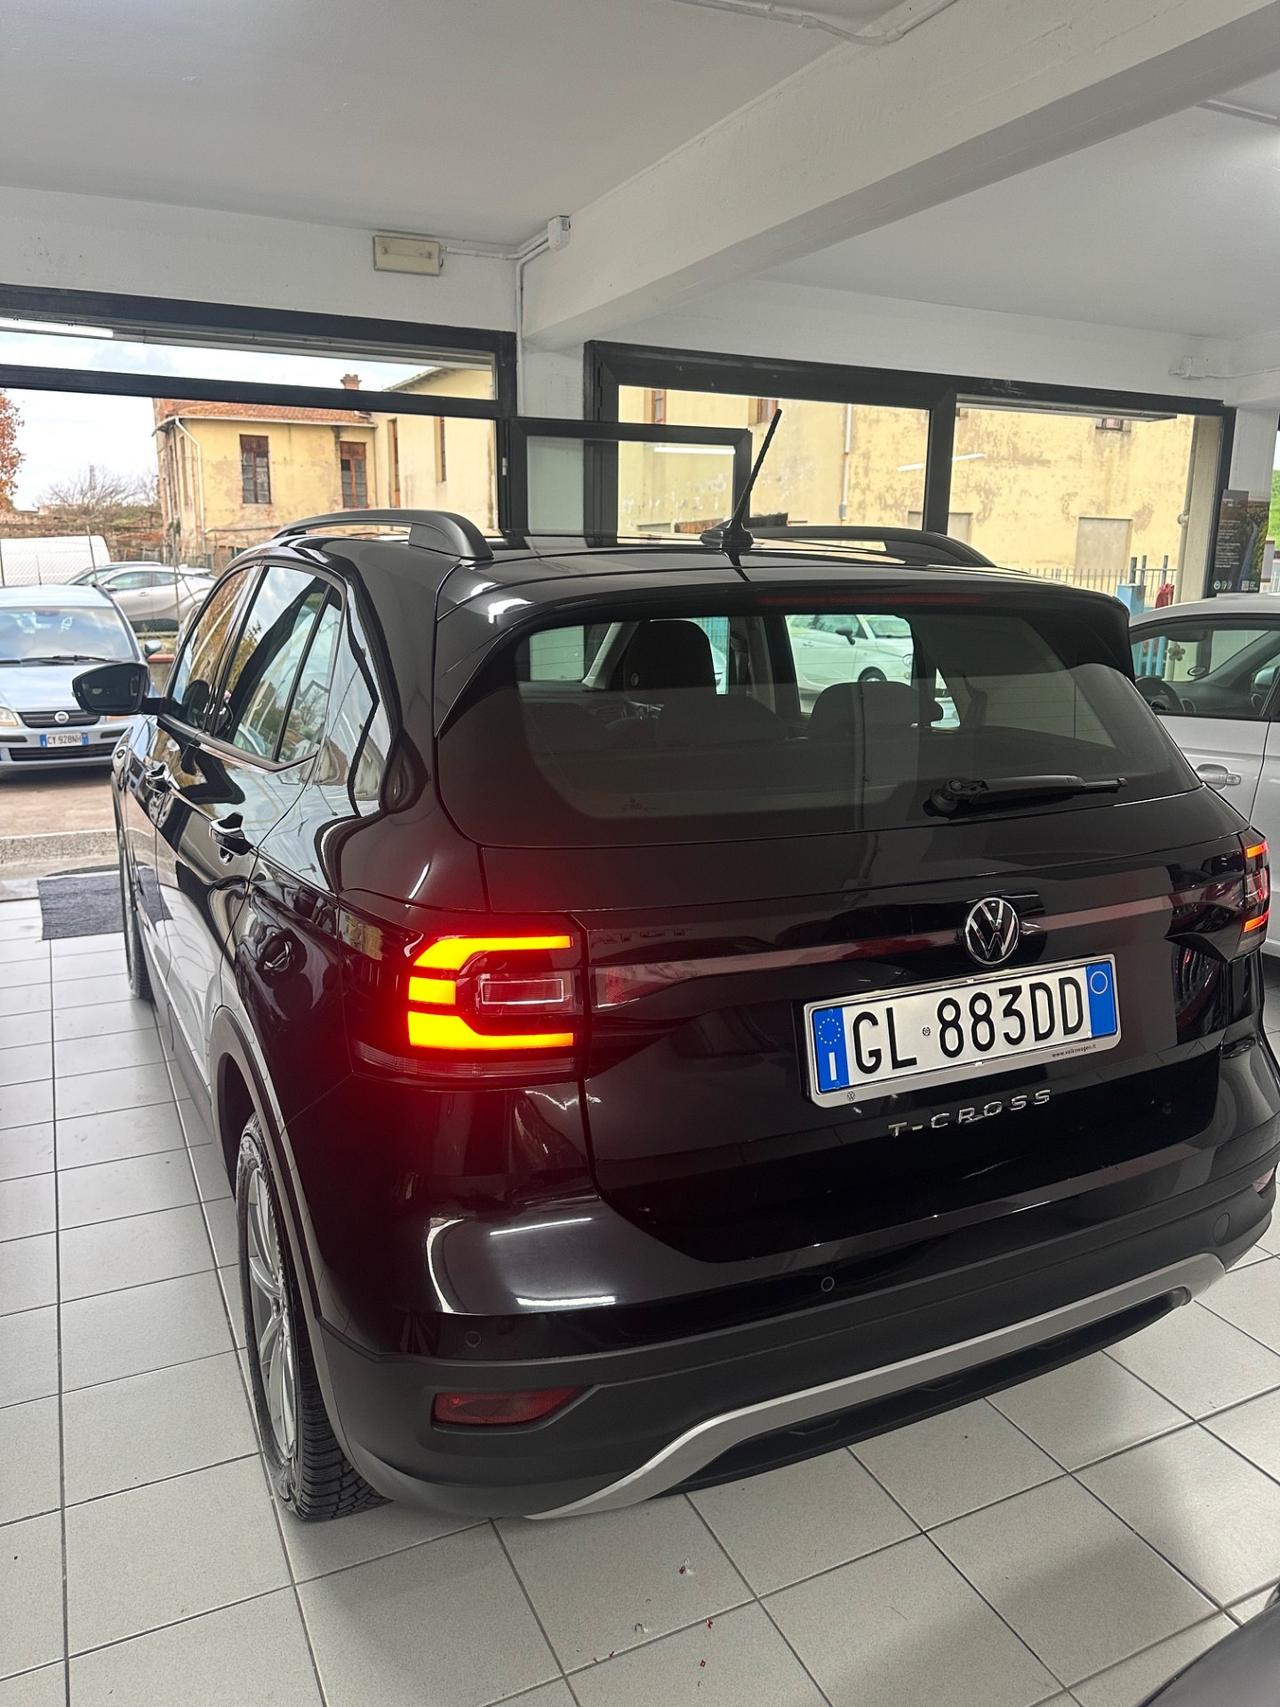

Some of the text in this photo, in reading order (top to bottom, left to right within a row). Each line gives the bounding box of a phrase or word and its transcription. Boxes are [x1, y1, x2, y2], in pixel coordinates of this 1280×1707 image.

[852, 1006, 918, 1075] GL
[936, 976, 1084, 1058] 883DD
[887, 1089, 1051, 1137] T-CROSS
